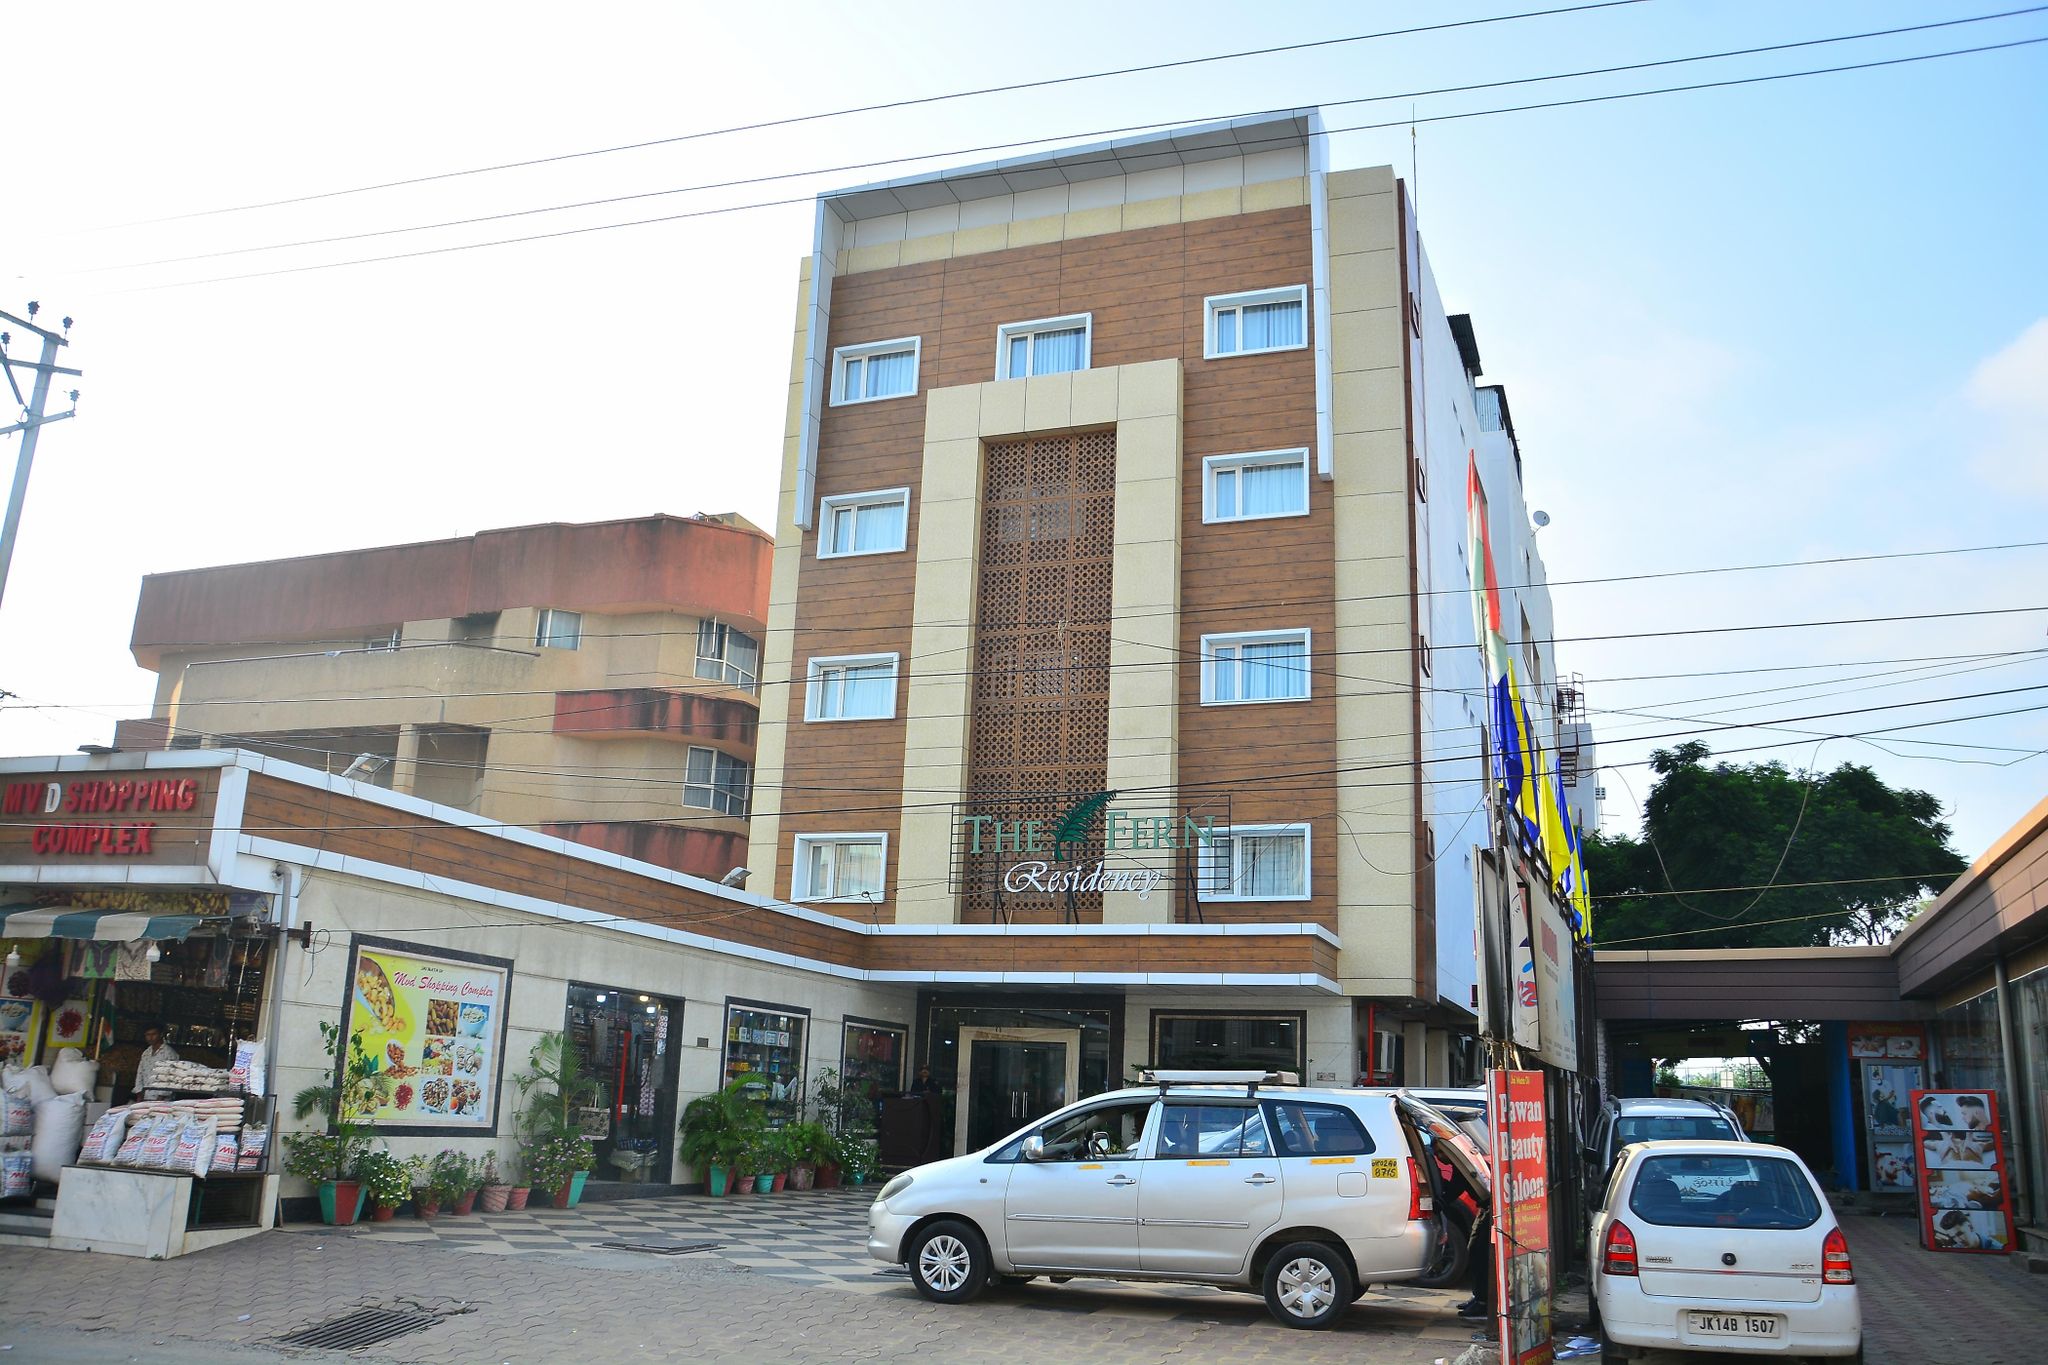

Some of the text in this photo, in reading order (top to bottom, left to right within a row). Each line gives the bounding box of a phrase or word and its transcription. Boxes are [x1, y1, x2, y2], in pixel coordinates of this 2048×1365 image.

[3, 778, 198, 815] MVD SHOPPING
[32, 820, 155, 855] COMPLEX
[961, 810, 1215, 854] THE FERN
[1004, 860, 1161, 900] Residency
[418, 976, 458, 996] Shopping
[460, 981, 494, 998] Complex
[1499, 1094, 1542, 1123] Pawan
[1500, 1131, 1544, 1164] Beauty
[1503, 1171, 1544, 1203] Saloon
[1699, 1316, 1775, 1334] JK14B 1507
